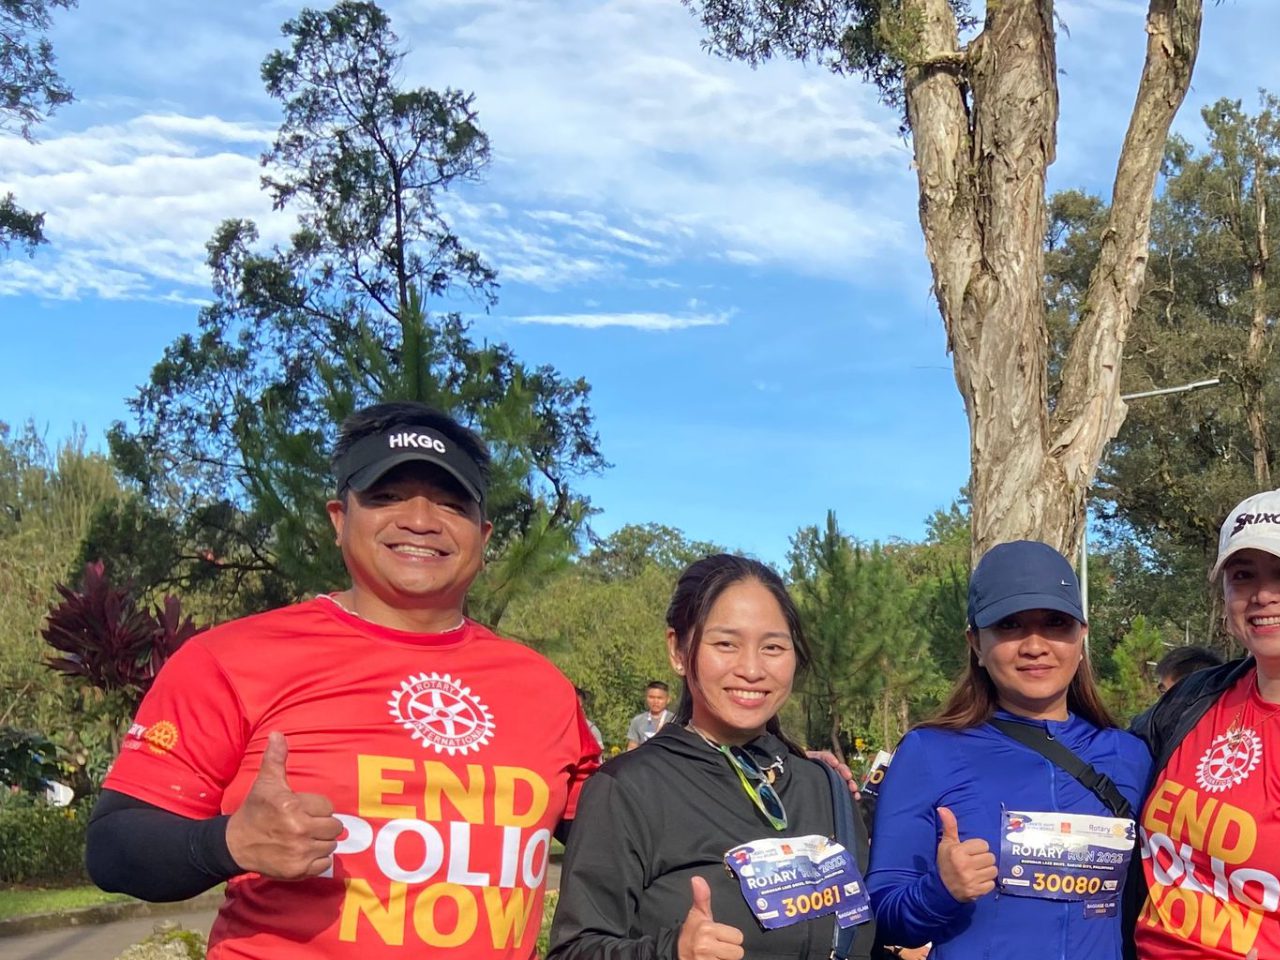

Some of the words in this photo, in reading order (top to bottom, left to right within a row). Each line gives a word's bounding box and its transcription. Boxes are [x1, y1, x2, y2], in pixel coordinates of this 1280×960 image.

[389, 432, 446, 453] HKGC
[416, 680, 456, 695] ROTARY
[414, 721, 486, 747] INTERNATIONAL
[357, 754, 550, 829] END
[1143, 779, 1258, 865] END
[1011, 843, 1064, 860] ROTARY
[1067, 849, 1095, 863] RUN
[746, 869, 798, 890] ROTARY
[1032, 871, 1101, 895] 30080
[338, 877, 538, 950] NOW
[782, 885, 841, 918] 30081
